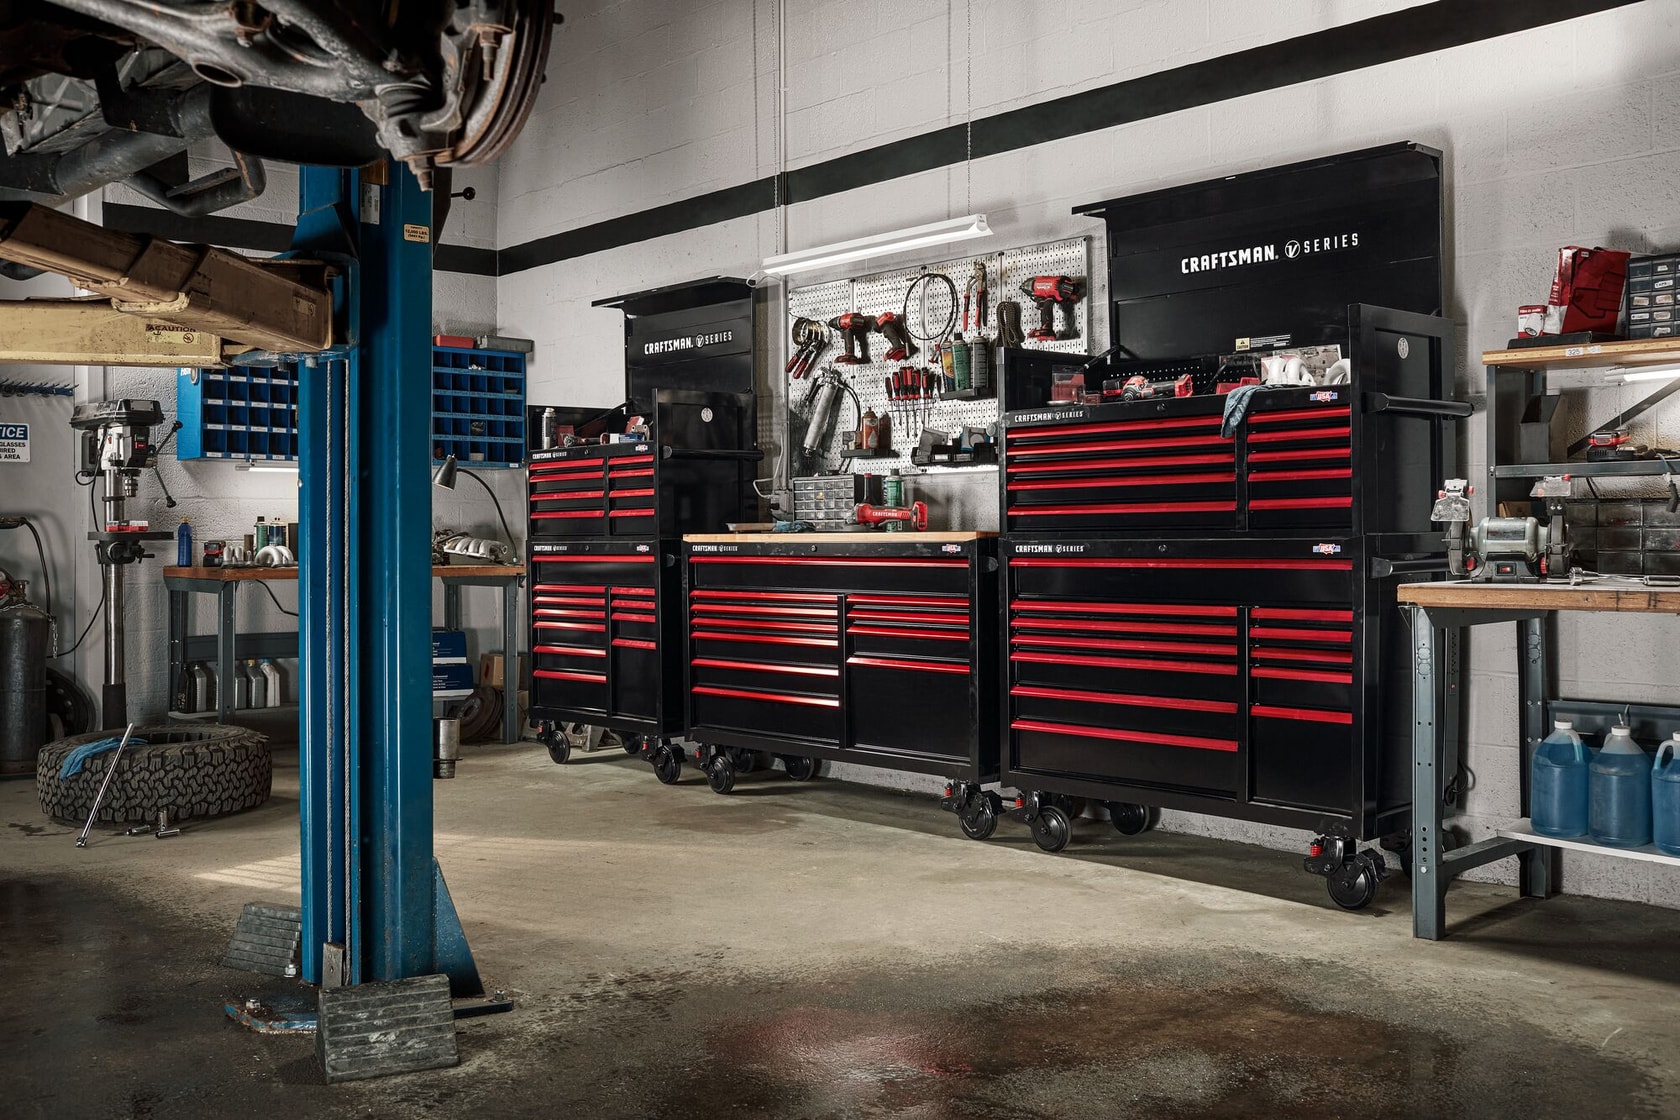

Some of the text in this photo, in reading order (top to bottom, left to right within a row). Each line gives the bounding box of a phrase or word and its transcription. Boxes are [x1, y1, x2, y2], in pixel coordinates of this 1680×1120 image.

[1181, 244, 1275, 274] CRAFTSMAN
[1304, 233, 1358, 253] SERIES
[705, 331, 732, 344] SERIES
[1015, 413, 1052, 422] CRAFTSMAN
